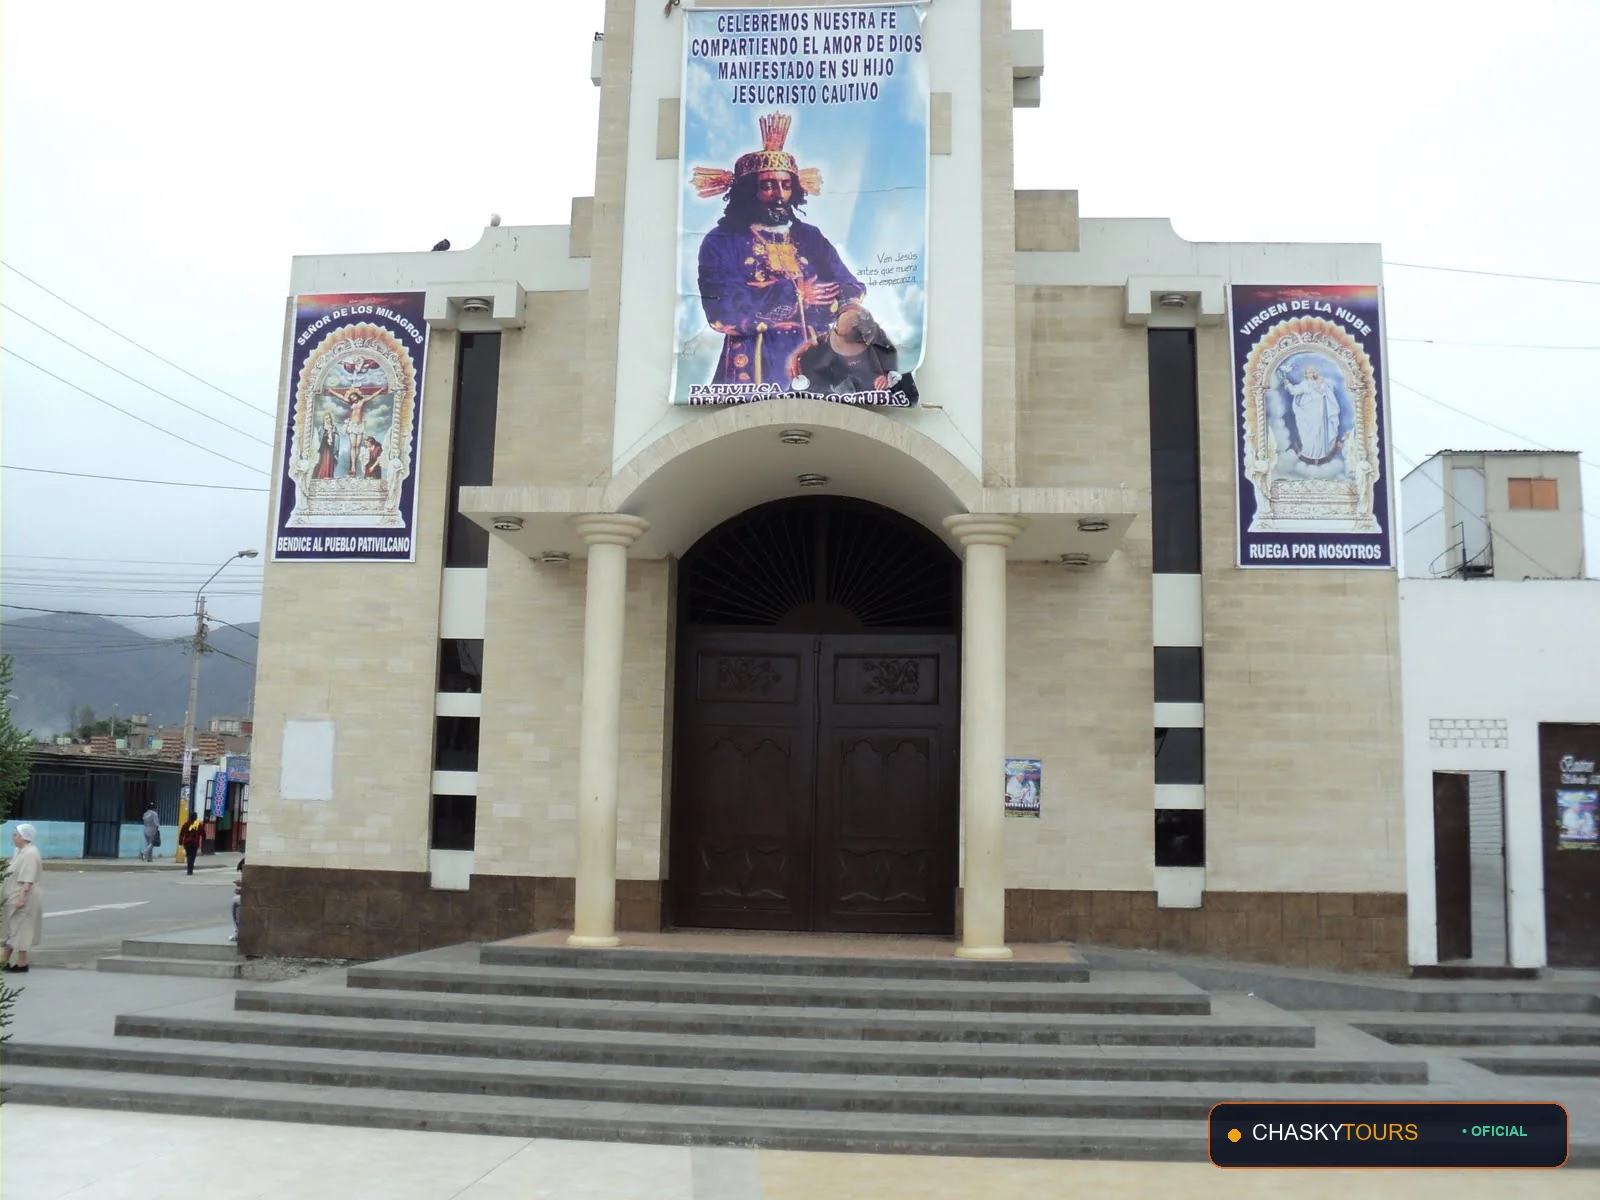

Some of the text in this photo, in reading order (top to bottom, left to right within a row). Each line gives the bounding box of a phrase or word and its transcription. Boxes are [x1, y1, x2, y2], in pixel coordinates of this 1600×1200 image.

[718, 13, 809, 33] CELEBREMOS
[814, 11, 875, 31] NUESTRA
[692, 34, 922, 57] COMPARTIENDO EL AMOR DE DIOS
[718, 58, 894, 80] MANIFESTADO EN SU HIJO
[732, 82, 879, 104] JESUCRISTO CAUTIVO
[877, 252, 918, 263] Ven Jesús
[856, 264, 918, 276] antes que muera
[297, 305, 424, 346] SEÑOR DE LOS MILAGROS
[1240, 300, 1372, 337] VIRGEN DE LA NUBE
[689, 384, 782, 395] PATIVILCA
[277, 536, 410, 553] BENDICE AL PUEBLO PATIVILCANO
[1250, 544, 1382, 560] RUEGA POR NOSOTROS
